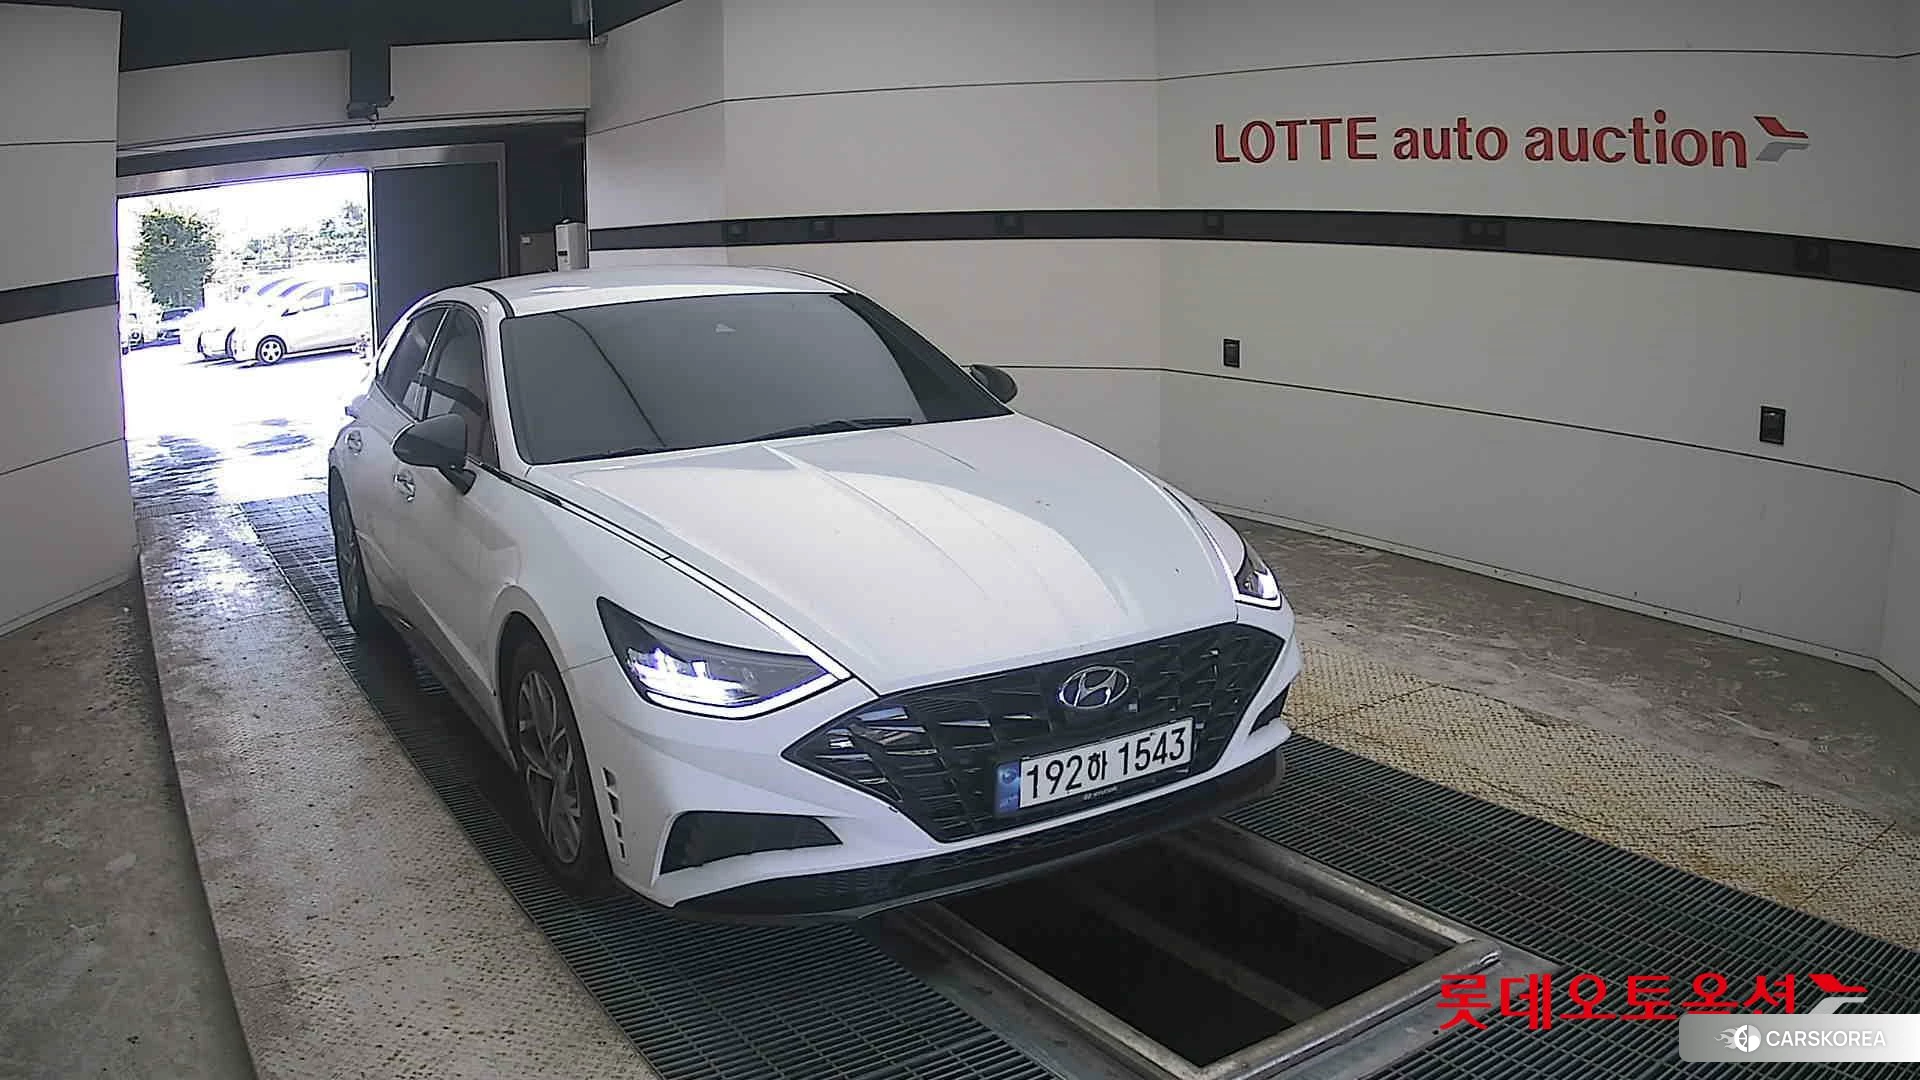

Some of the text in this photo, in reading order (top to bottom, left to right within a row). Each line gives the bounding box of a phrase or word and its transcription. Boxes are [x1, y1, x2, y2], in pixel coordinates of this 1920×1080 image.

[1214, 109, 1748, 168] LOTTE auto auction
[1026, 727, 1187, 799] 192하 1543
